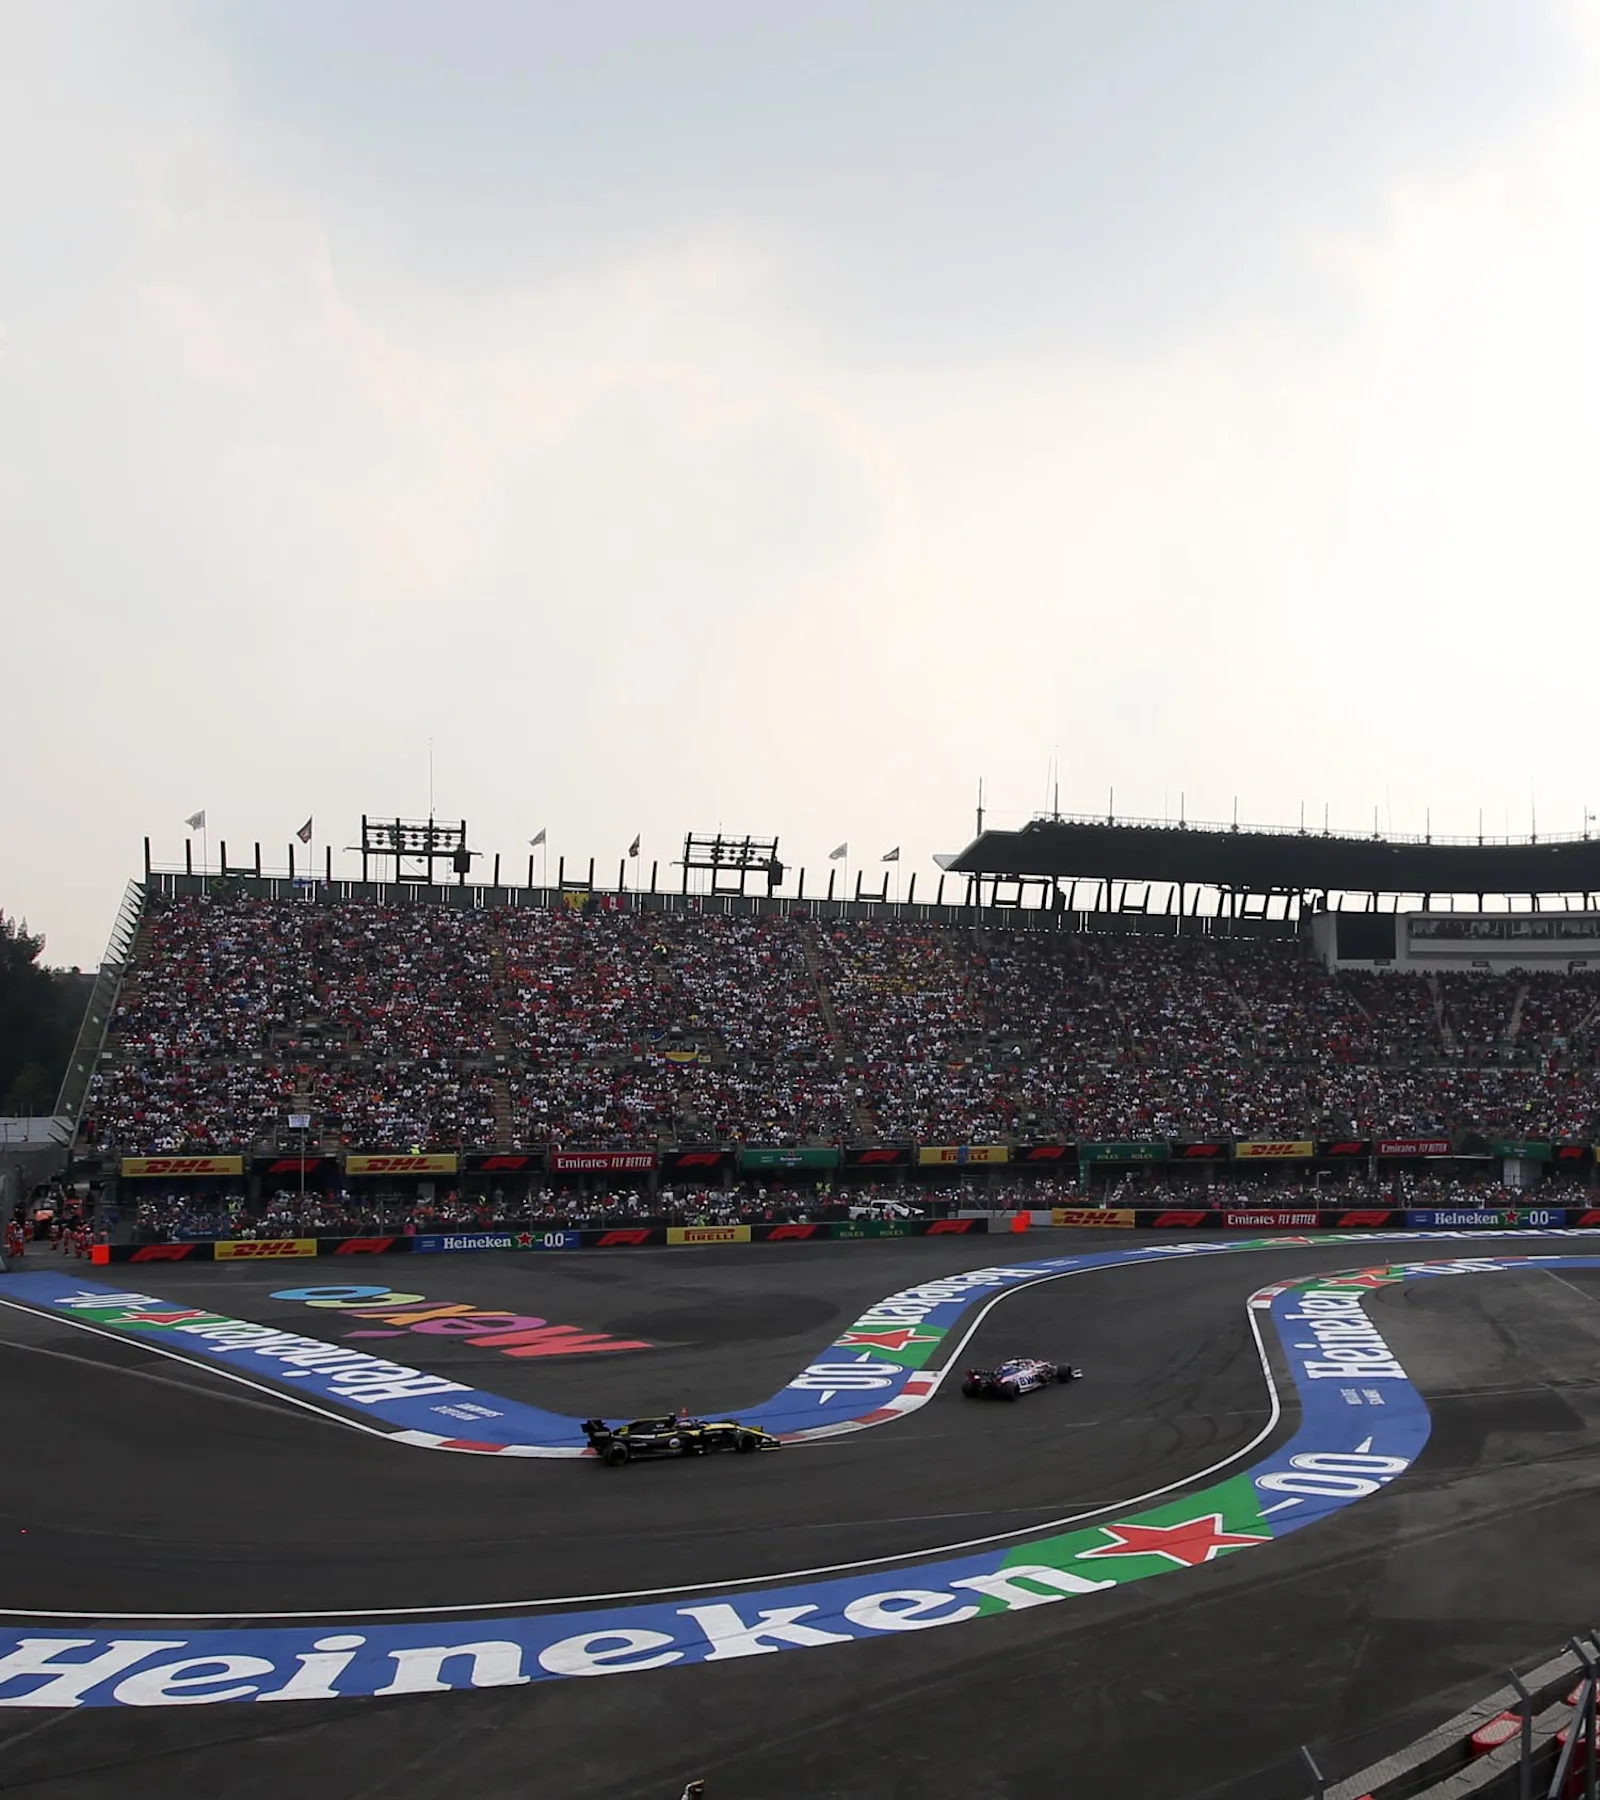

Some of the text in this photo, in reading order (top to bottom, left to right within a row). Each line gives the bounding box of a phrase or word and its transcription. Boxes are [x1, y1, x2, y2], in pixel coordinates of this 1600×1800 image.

[1250, 1144, 1294, 1155] DHL
[1381, 1143, 1417, 1153] Emirates
[145, 1159, 215, 1174] DHL
[365, 1157, 431, 1171] DHL
[557, 1155, 652, 1169] Emirates FLY BETTER
[1063, 1211, 1122, 1225] DHL
[1227, 1213, 1317, 1226] Emirates FLY BETTER
[1433, 1213, 1499, 1226] Heineken
[684, 1228, 735, 1241] PIRELLI
[232, 1242, 300, 1257] DHL
[442, 1236, 512, 1250] Heineken
[852, 1268, 1052, 1328] Heineken
[1284, 1290, 1409, 1380] Heineken
[174, 1320, 476, 1404] Heineken
[0, 1564, 1117, 1708] Heineken
